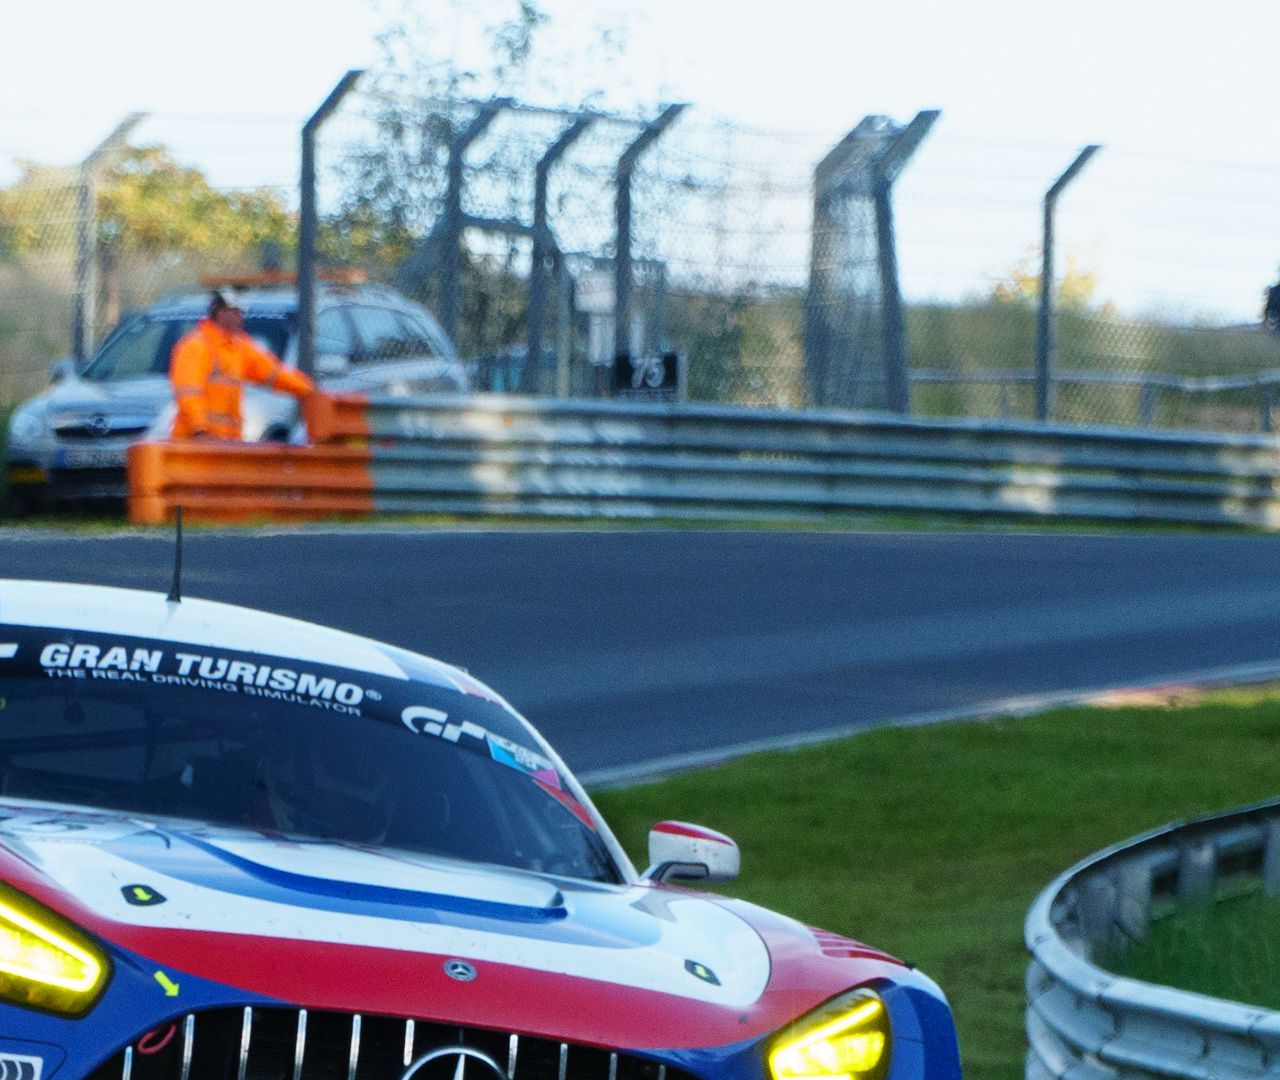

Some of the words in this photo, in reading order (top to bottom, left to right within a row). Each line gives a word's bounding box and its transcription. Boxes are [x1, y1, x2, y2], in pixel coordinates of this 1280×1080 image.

[39, 642, 163, 672] GRAN
[43, 668, 87, 679] THE
[91, 668, 148, 682] REAL
[152, 674, 239, 693] DRIVING
[243, 685, 362, 717] SIMULATOR
